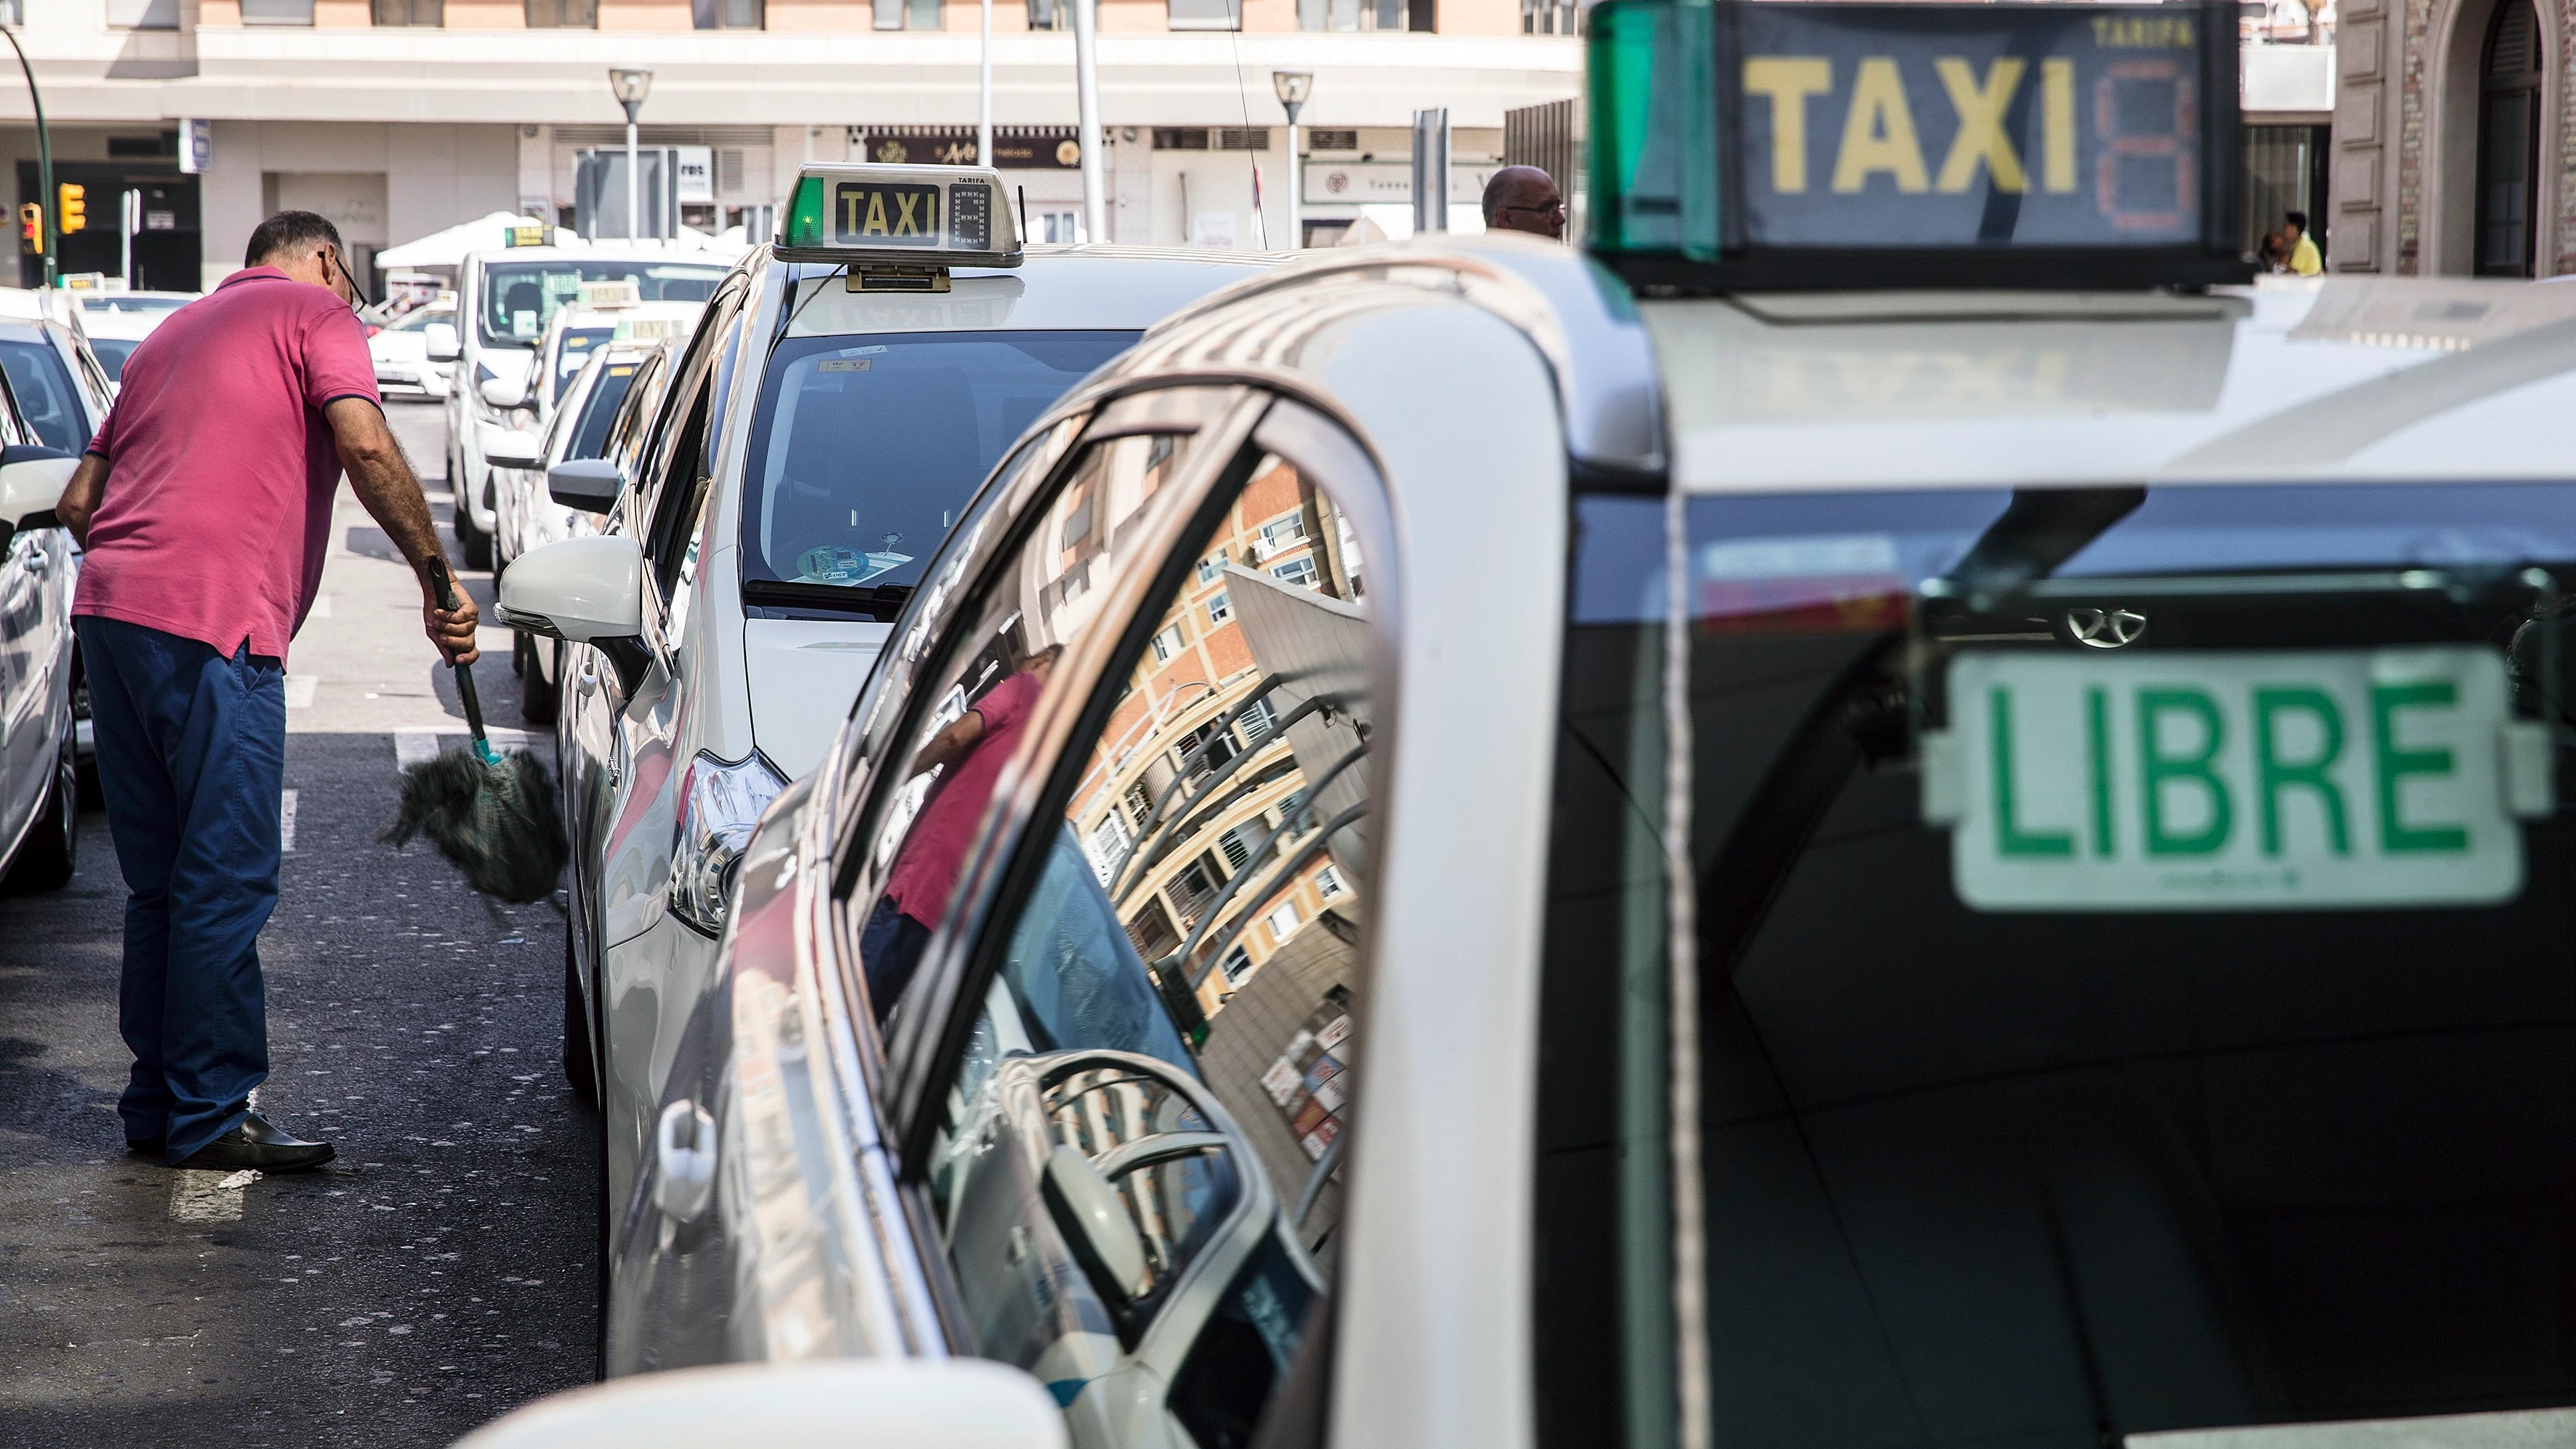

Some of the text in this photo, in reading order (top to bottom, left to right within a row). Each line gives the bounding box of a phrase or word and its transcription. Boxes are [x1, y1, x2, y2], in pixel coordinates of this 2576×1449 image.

[2092, 17, 2195, 48] TARIFA
[1743, 56, 2077, 194] TAXI
[840, 190, 936, 238] TAXI
[1989, 682, 2469, 859] LIBRE
